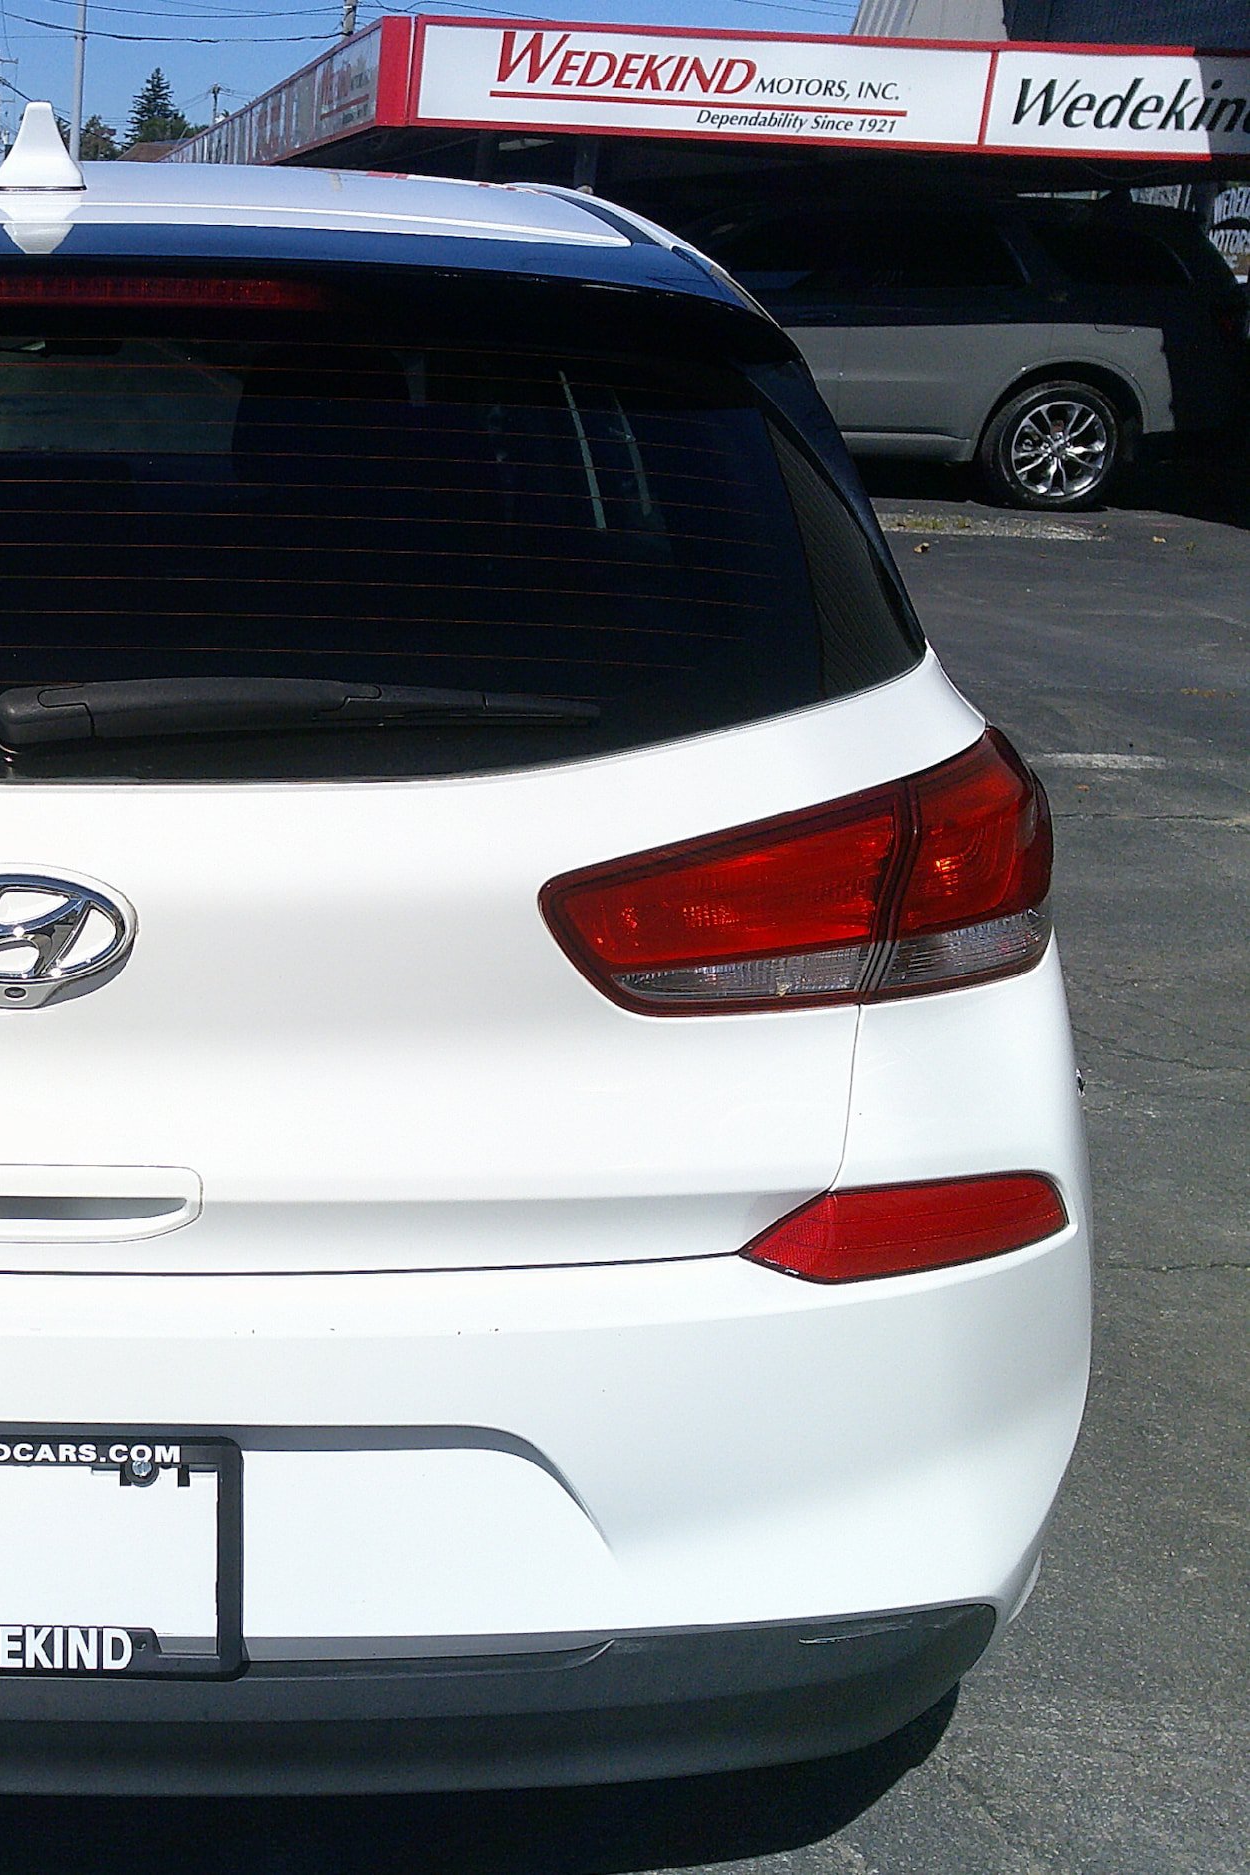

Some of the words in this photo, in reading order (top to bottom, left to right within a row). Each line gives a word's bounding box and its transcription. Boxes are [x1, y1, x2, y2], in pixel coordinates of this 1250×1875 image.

[497, 31, 757, 94] WEDEKIND
[755, 77, 851, 101] MOTORS,
[857, 81, 900, 101] INC.
[696, 109, 808, 133] Dependability
[811, 115, 854, 131] Since
[857, 118, 897, 133] 1921
